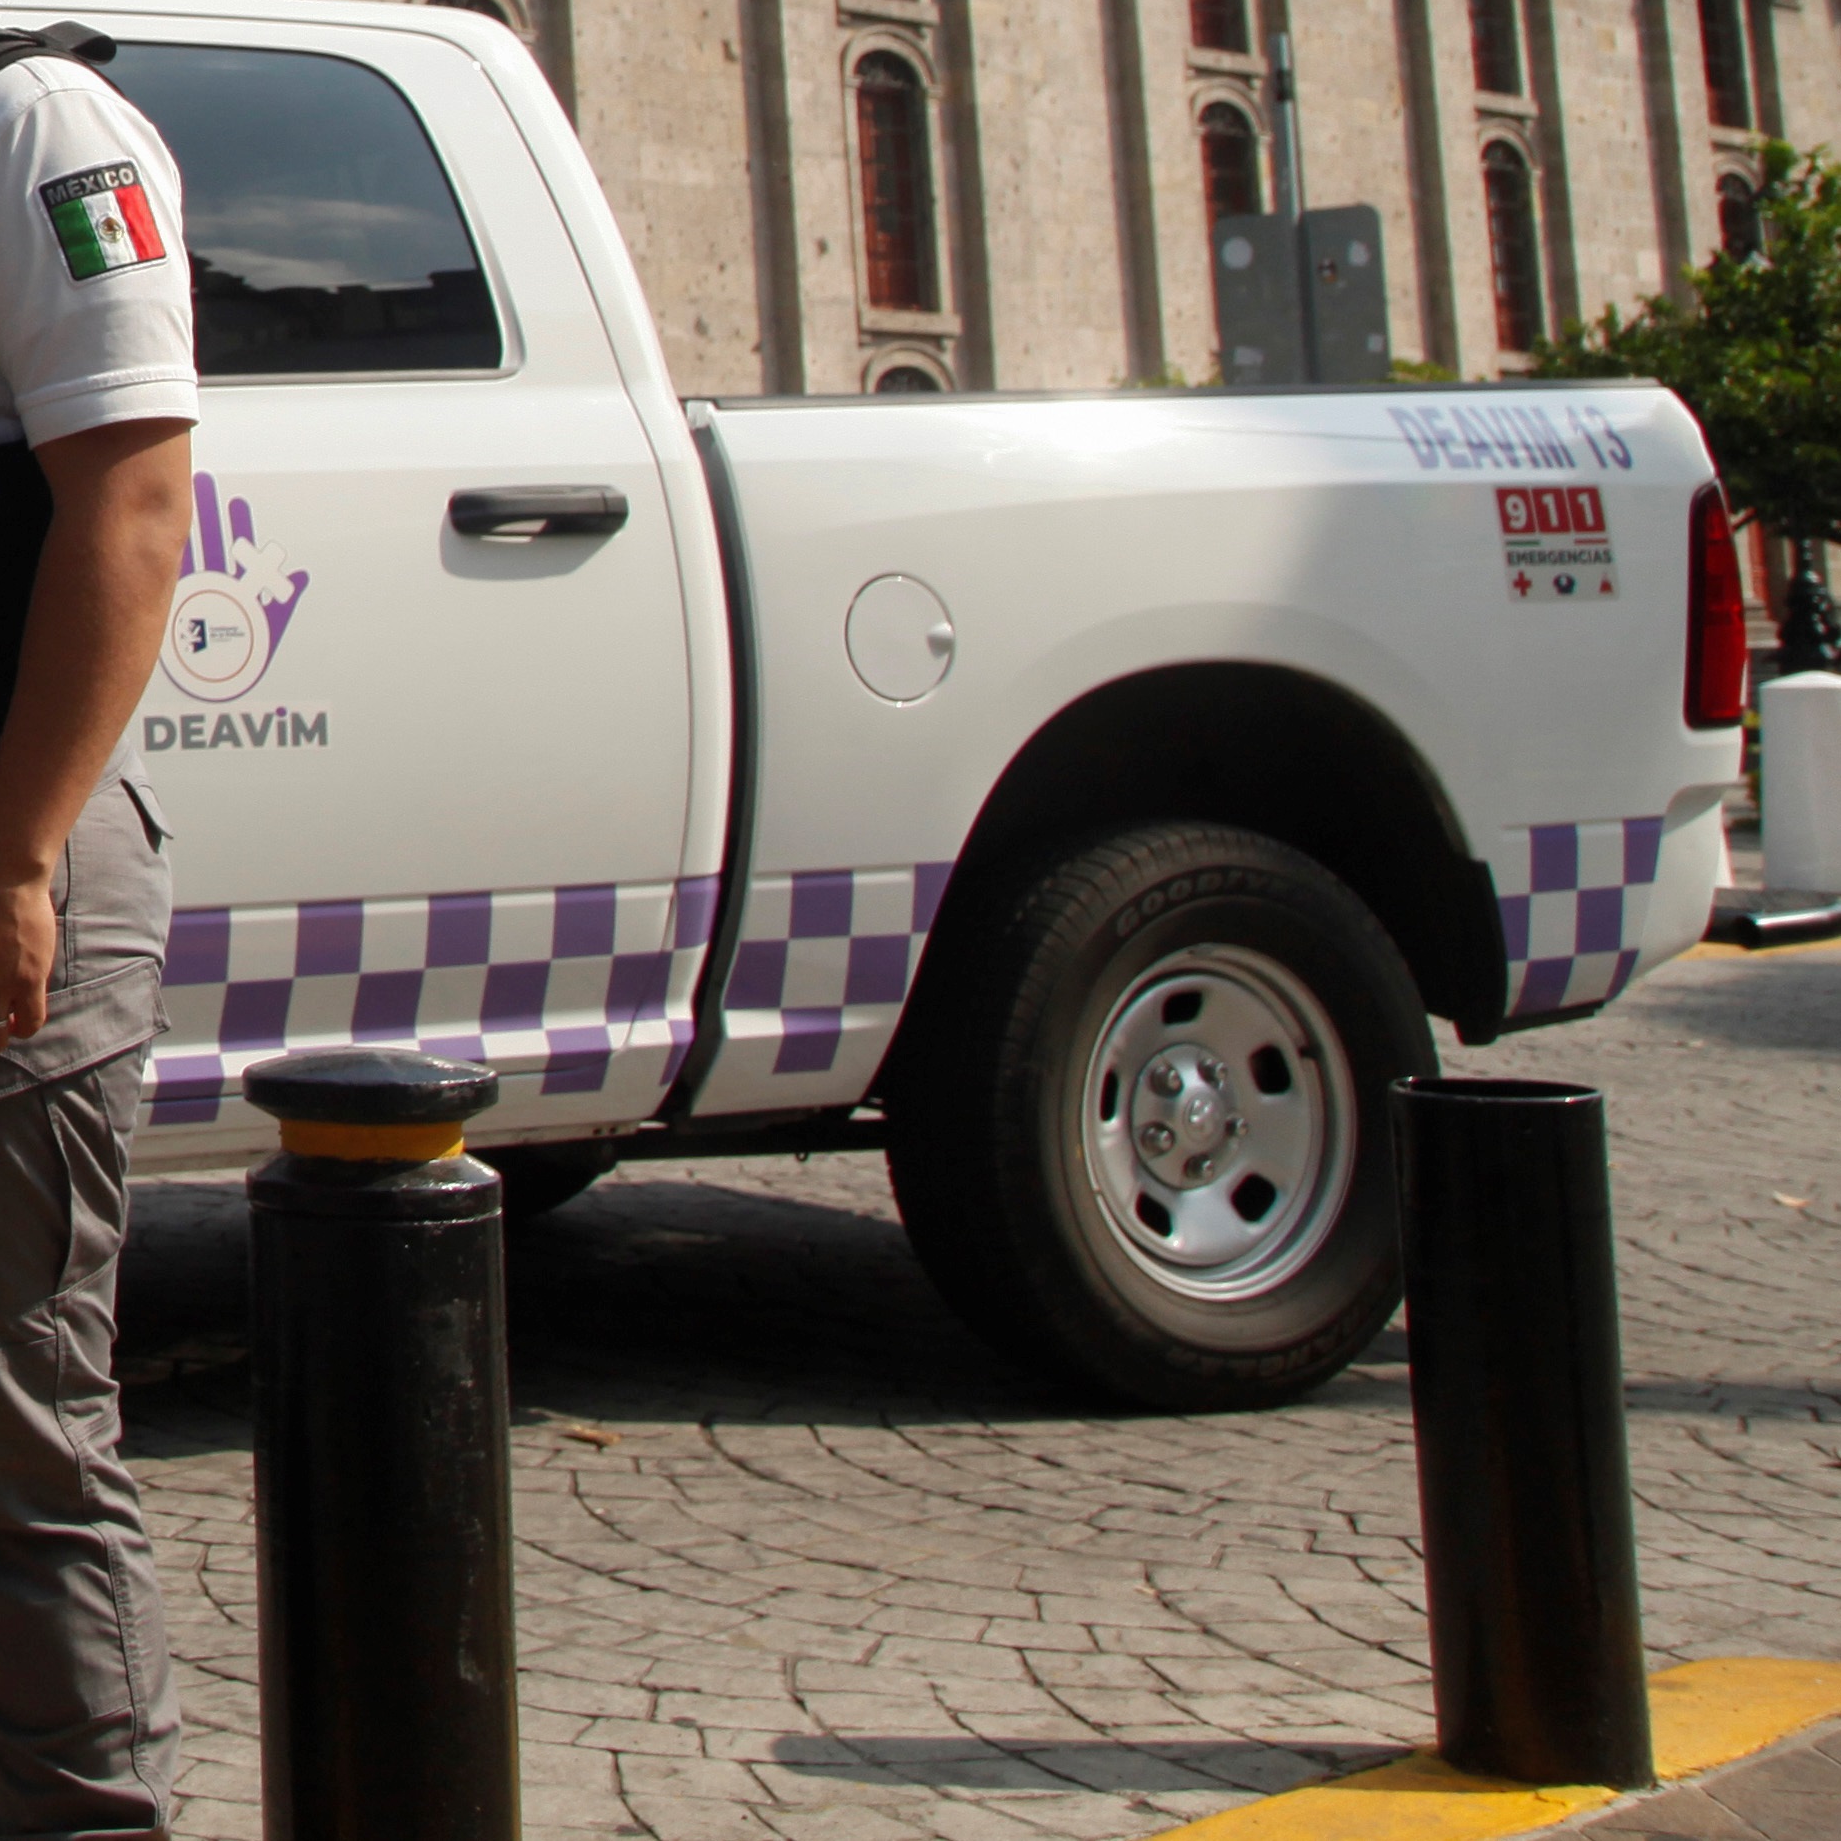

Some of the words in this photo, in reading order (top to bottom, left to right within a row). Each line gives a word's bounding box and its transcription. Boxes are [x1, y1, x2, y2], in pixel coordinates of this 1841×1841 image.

[1388, 406, 1577, 470] DEAVIM
[1566, 406, 1633, 470] 13
[1504, 492, 1595, 531] 911
[1506, 549, 1612, 566] EMERGENCIAS
